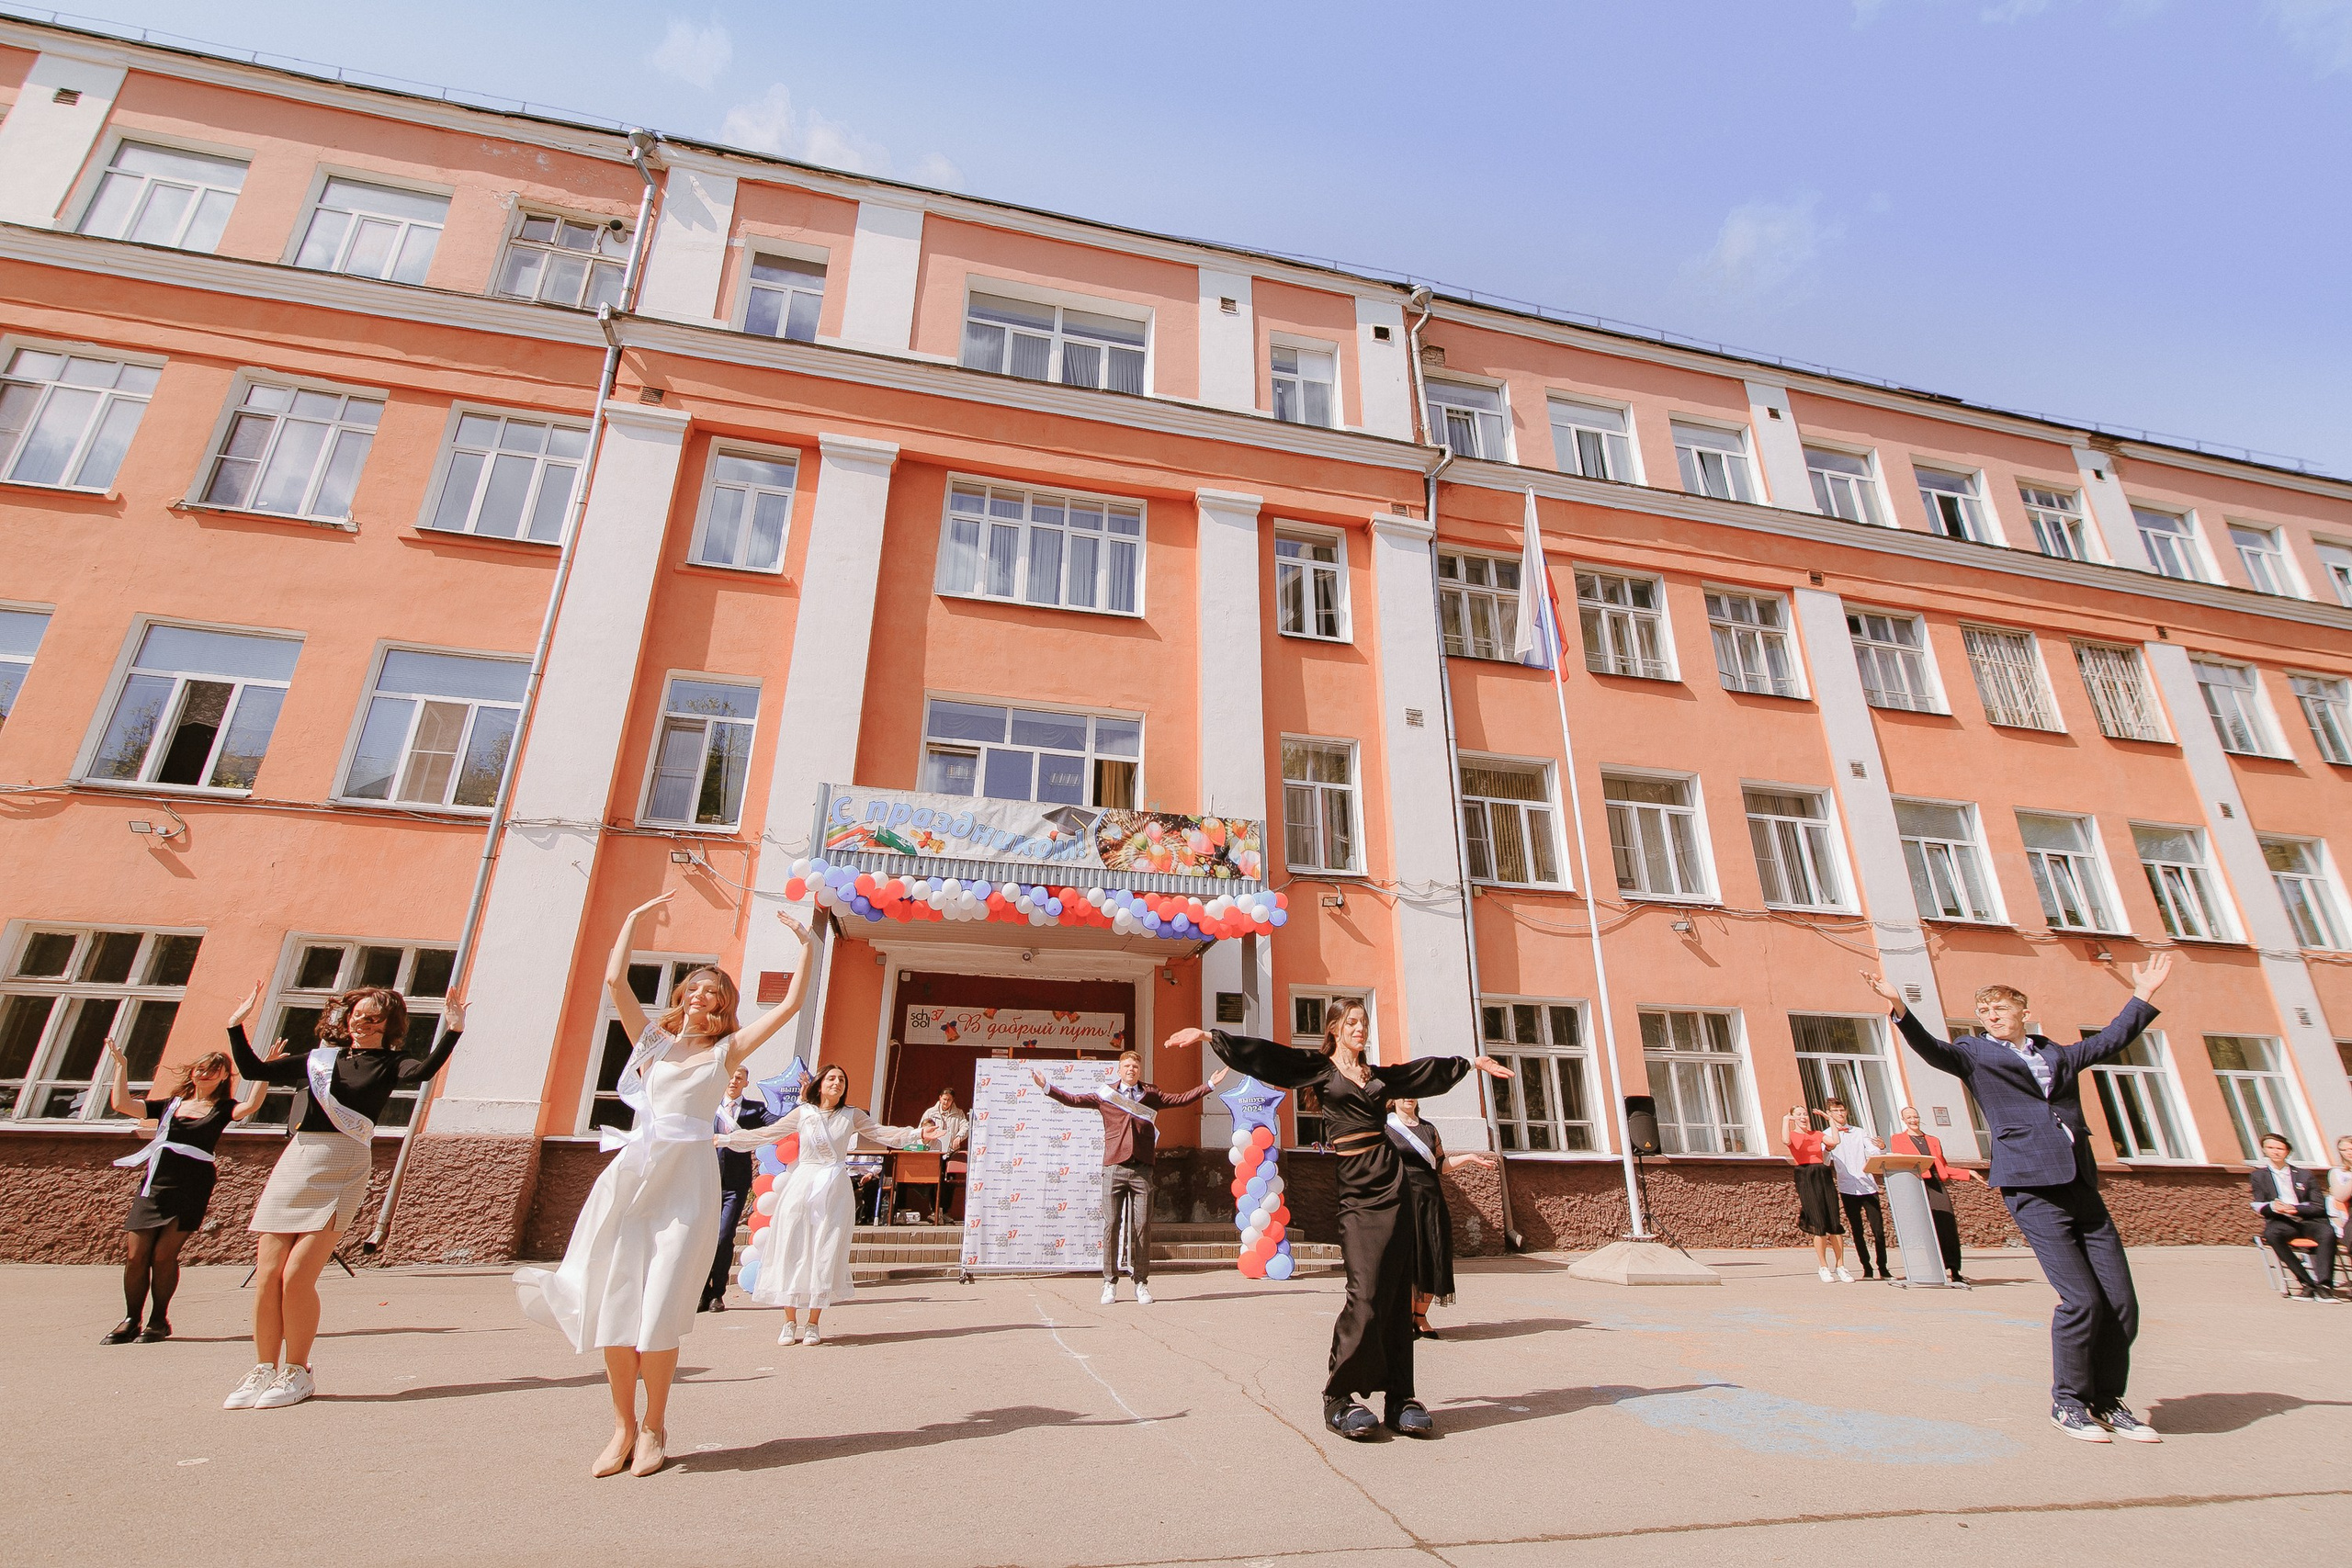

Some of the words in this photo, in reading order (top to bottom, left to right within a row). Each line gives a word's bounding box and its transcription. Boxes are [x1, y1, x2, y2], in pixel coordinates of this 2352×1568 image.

[831, 795, 854, 825] С
[865, 802, 1087, 861] праздником!
[910, 1009, 929, 1021] sch
[931, 1010, 944, 1021] 37
[911, 1017, 930, 1029] ool
[957, 1013, 981, 1033] В
[987, 1016, 1056, 1040] добрый
[1059, 1021, 1114, 1043] путь!
[1065, 1065, 1074, 1073] 37
[981, 1077, 991, 1087] 37
[1016, 1089, 1027, 1097] 37
[978, 1111, 989, 1121] 37
[1015, 1122, 1025, 1132] 37
[1062, 1132, 1071, 1141] 37
[977, 1146, 987, 1155] 37
[1012, 1157, 1023, 1167] 37
[1059, 1167, 1069, 1176] 37
[973, 1182, 984, 1191] 37
[1010, 1193, 1021, 1202] 37
[1057, 1202, 1068, 1211] 37
[970, 1219, 981, 1228] 37
[1008, 1229, 1018, 1239] 37
[1056, 1238, 1065, 1247] 37
[1097, 1241, 1102, 1249] 3
[967, 1256, 978, 1265] 37
